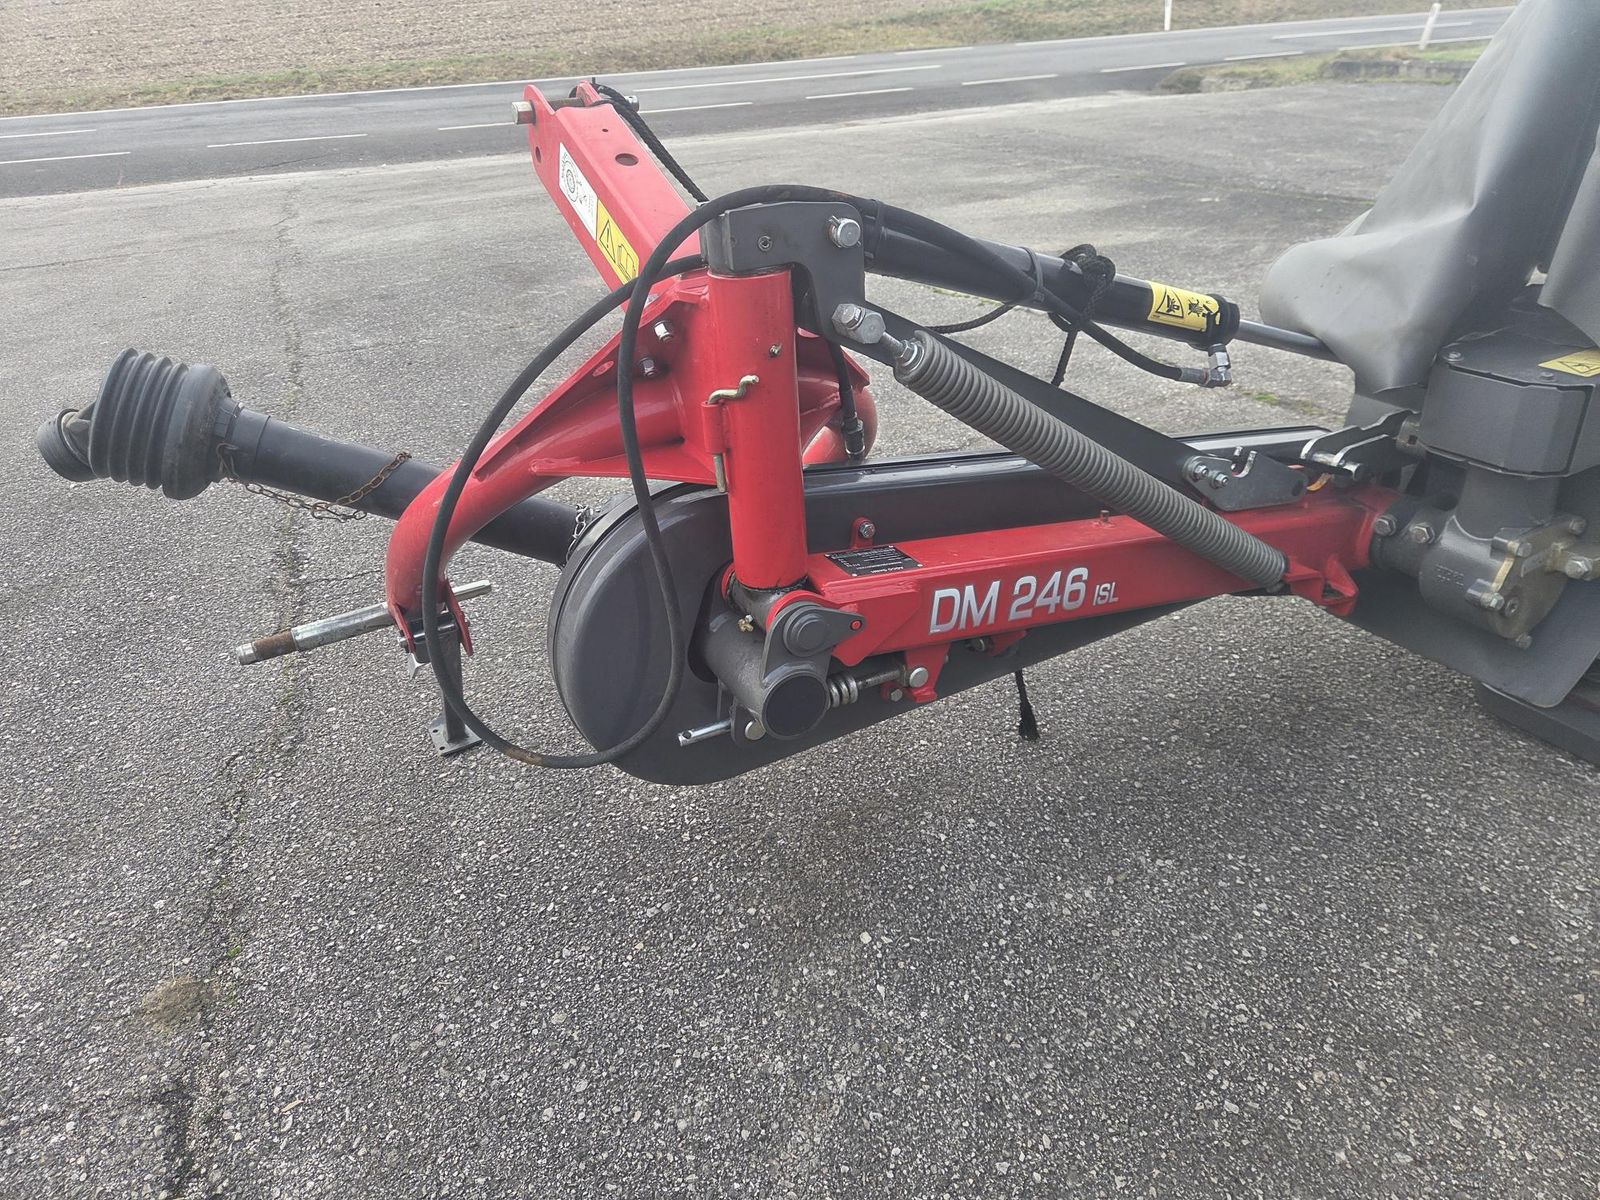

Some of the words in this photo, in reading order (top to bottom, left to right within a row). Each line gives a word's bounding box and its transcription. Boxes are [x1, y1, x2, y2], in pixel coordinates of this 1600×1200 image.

[929, 580, 1001, 635] DM
[1008, 567, 1088, 621] 246
[1093, 582, 1118, 606] ISL
